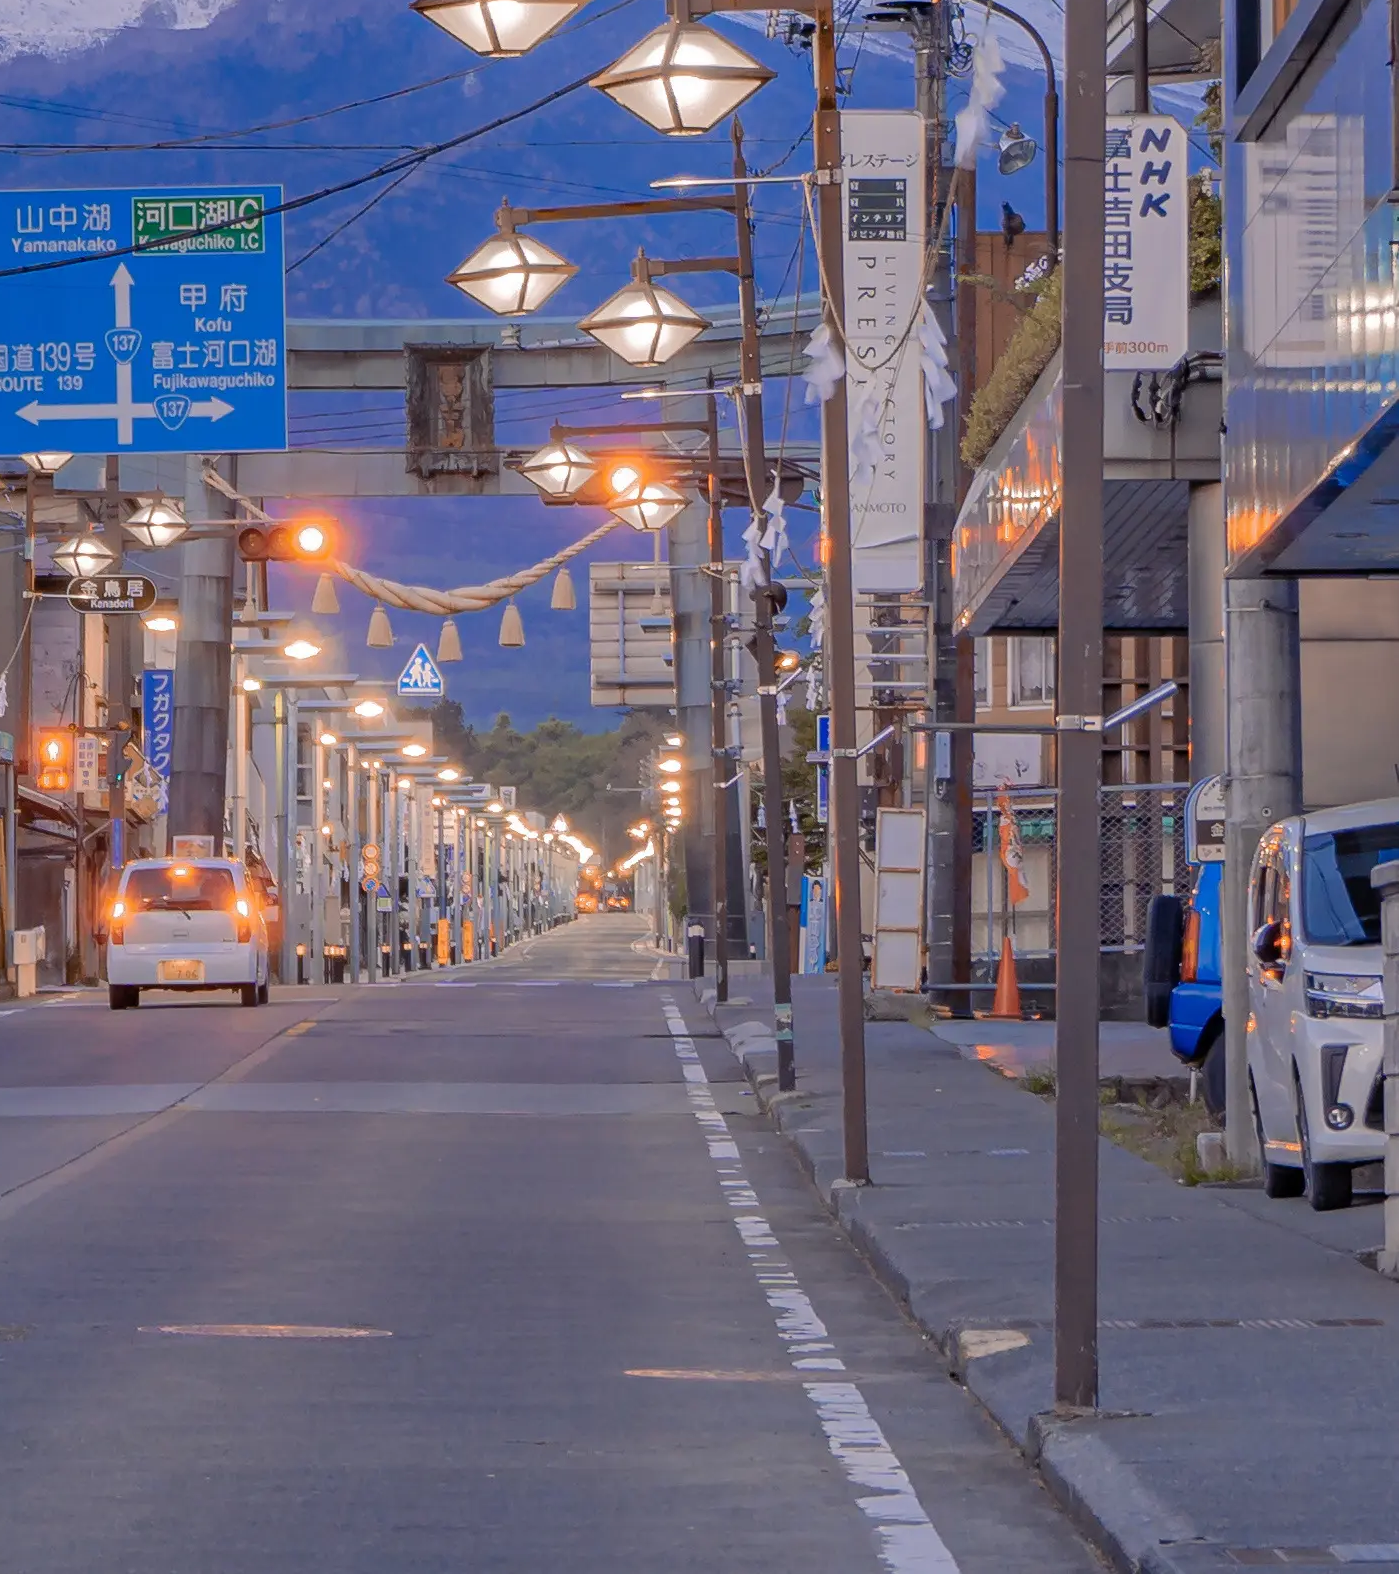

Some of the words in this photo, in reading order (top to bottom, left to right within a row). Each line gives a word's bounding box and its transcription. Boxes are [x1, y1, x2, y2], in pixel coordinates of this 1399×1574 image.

[1139, 128, 1172, 217] NHK
[16, 203, 111, 233] 山中湖
[852, 214, 904, 223] インテリア
[1104, 129, 1133, 325] 富士吉田支局
[12, 237, 116, 253] Yamanakako
[179, 282, 248, 313] 甲府
[884, 256, 896, 346] LIVING
[194, 317, 232, 333] Kofu
[111, 335, 135, 351] 137
[151, 339, 277, 370] 富士河口湖
[57, 375, 83, 391] 139
[153, 373, 275, 392] Fujikawaguchiko
[161, 401, 185, 417] 137
[852, 503, 907, 514] ANMOTO
